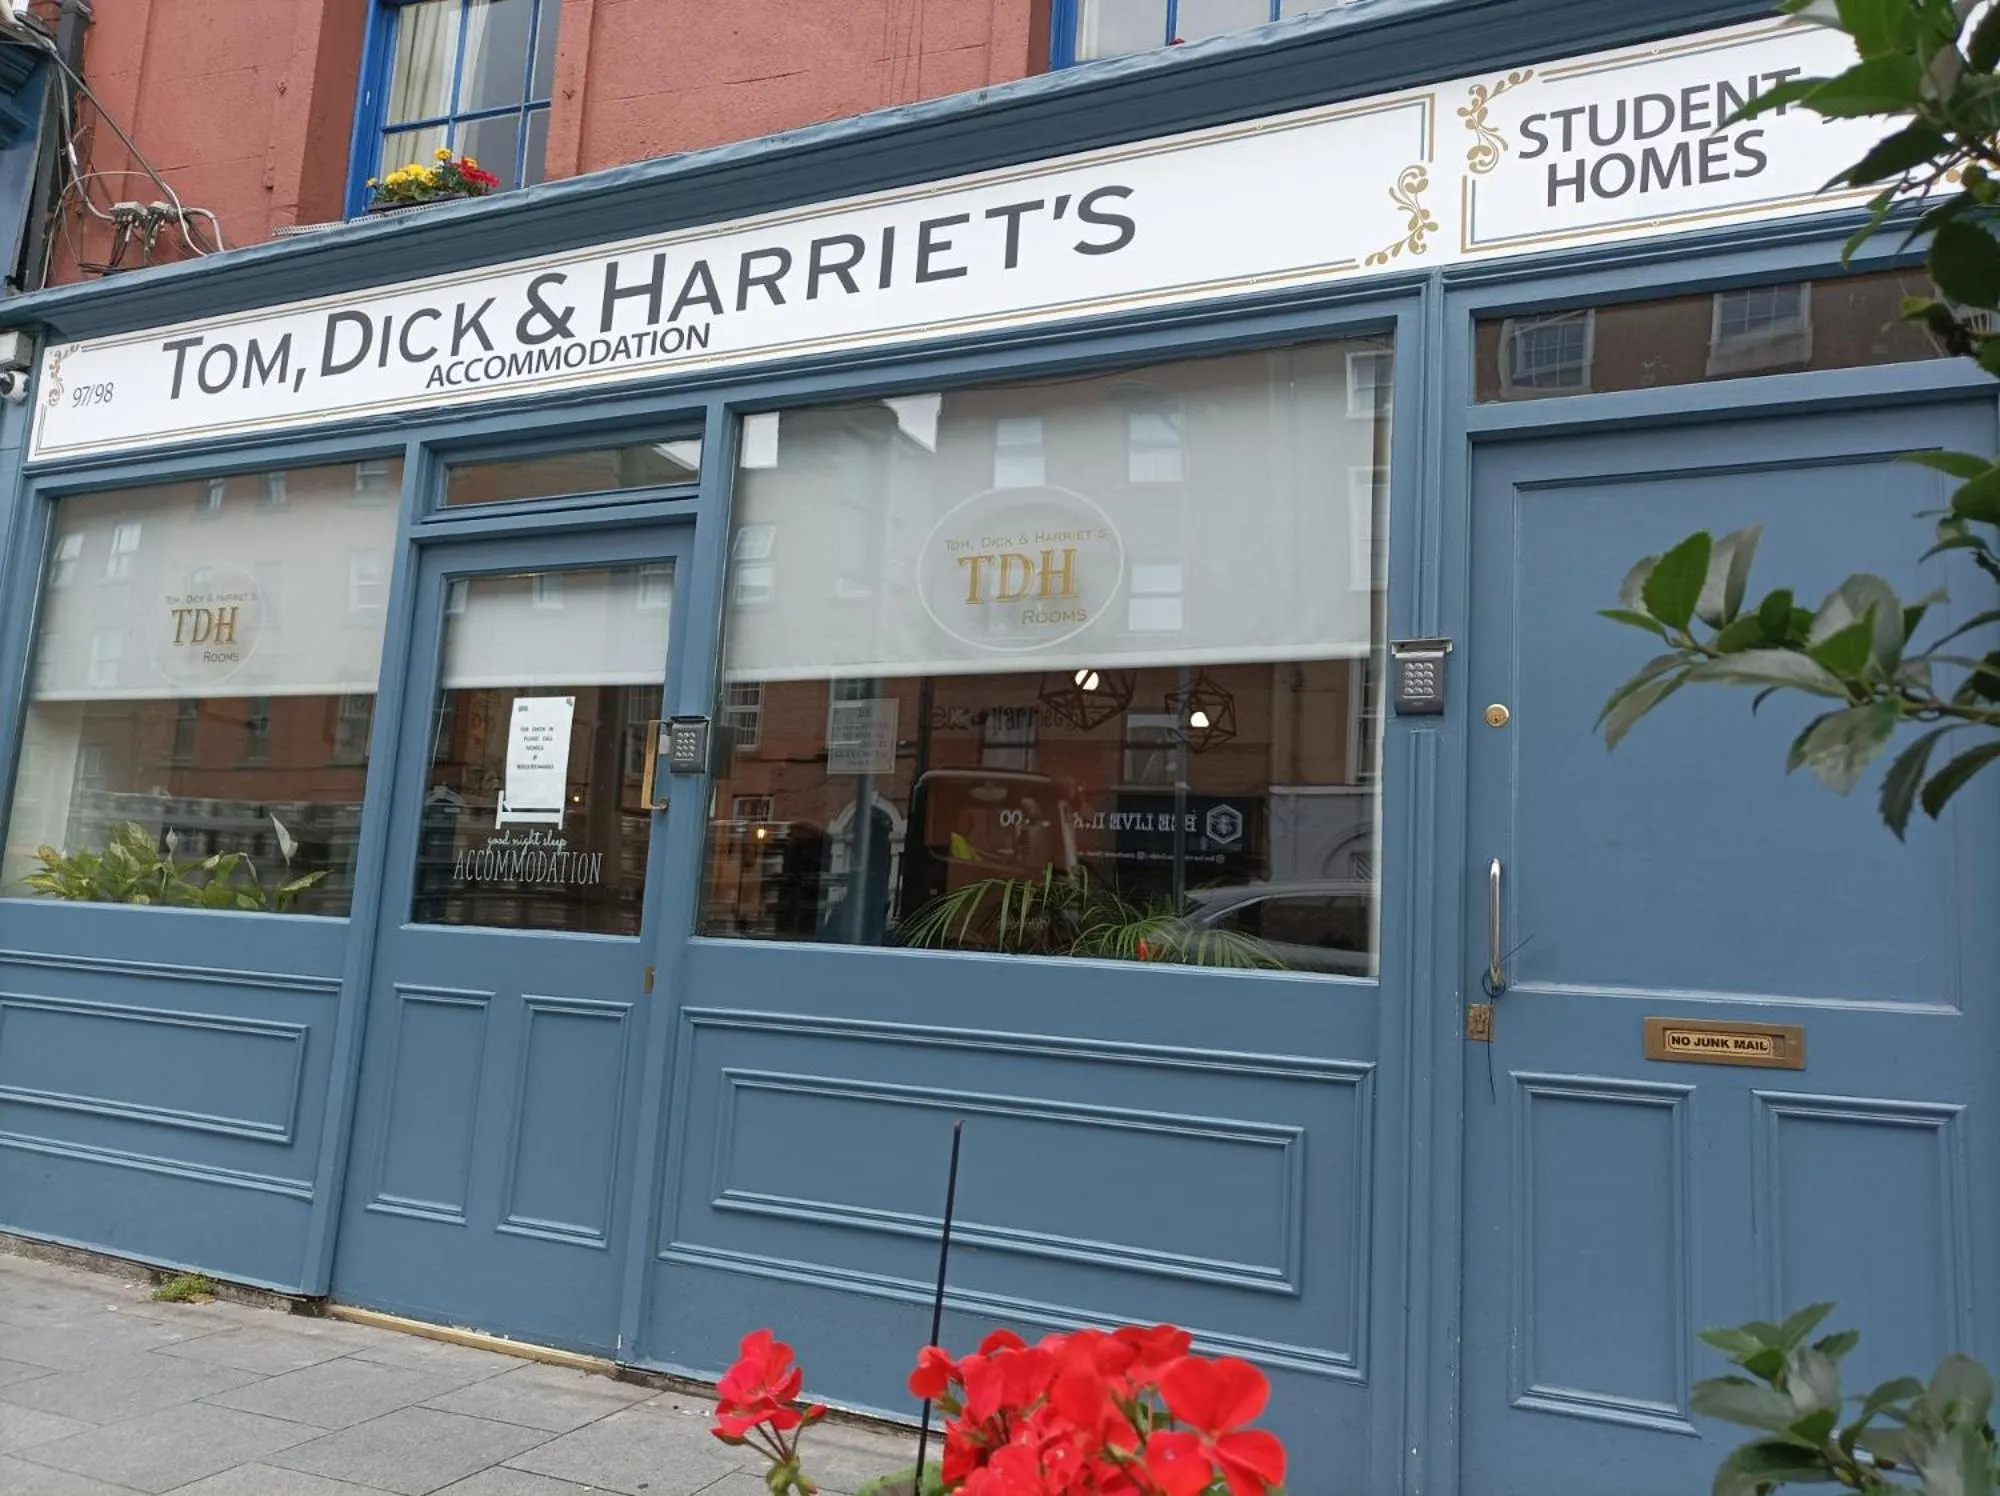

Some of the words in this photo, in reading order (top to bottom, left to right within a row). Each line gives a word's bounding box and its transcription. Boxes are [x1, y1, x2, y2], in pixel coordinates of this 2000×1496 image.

[1519, 67, 1801, 159] STUDENT
[1548, 130, 1766, 207] HOMES
[321, 298, 497, 377] DICK
[516, 273, 576, 345] &
[600, 186, 1136, 333] HARRIET'S
[426, 323, 711, 389] ACCOMMODATION
[72, 382, 114, 408] 97/98
[957, 547, 1080, 604] TDH
[171, 606, 239, 646] TDH
[1022, 608, 1088, 625] ROOMS
[203, 651, 241, 663] ROOMS
[487, 829, 510, 855] good
[512, 828, 541, 856] night
[543, 828, 568, 856] sleep
[453, 849, 604, 885] ACCOMMODATION
[1671, 1035, 1691, 1046] NO
[1694, 1037, 1731, 1049] JUNK
[1734, 1040, 1768, 1051] MAIL
